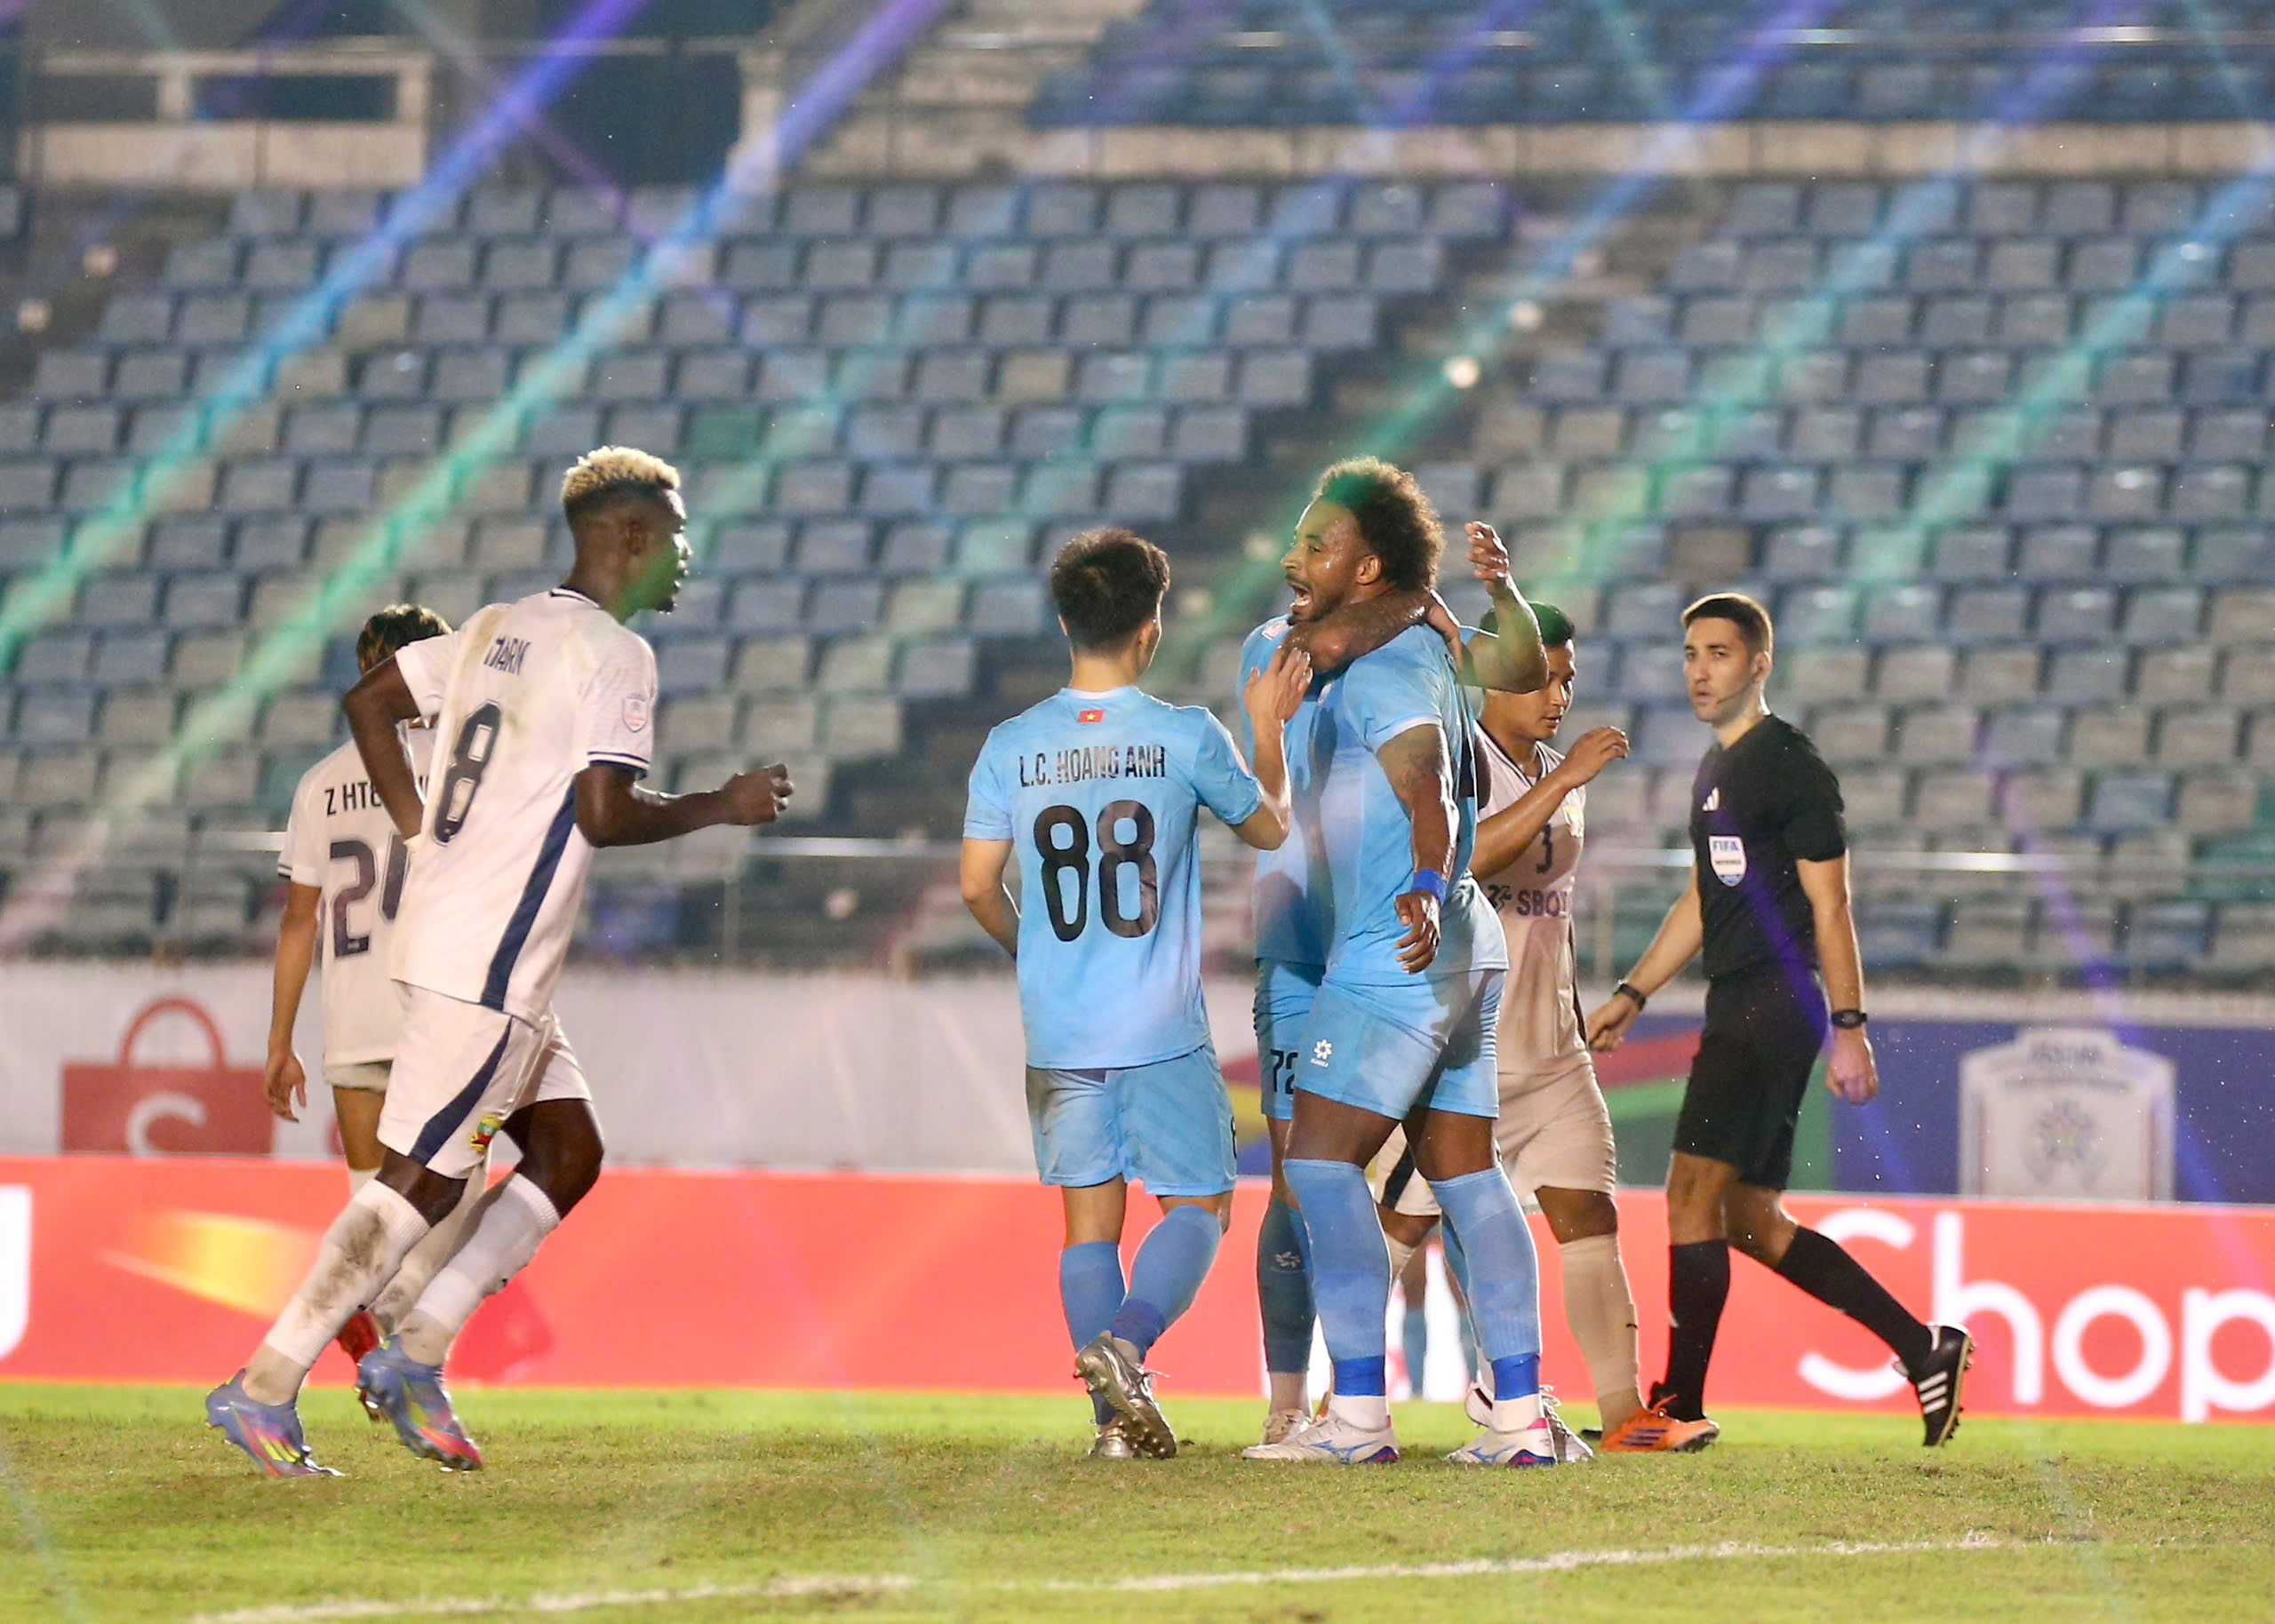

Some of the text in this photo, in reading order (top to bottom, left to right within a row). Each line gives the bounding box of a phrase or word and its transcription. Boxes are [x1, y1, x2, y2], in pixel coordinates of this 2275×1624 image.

[435, 699, 501, 847] 8
[1019, 744, 1166, 788] L.C. HOANG ANH
[1034, 799, 1159, 943] 88
